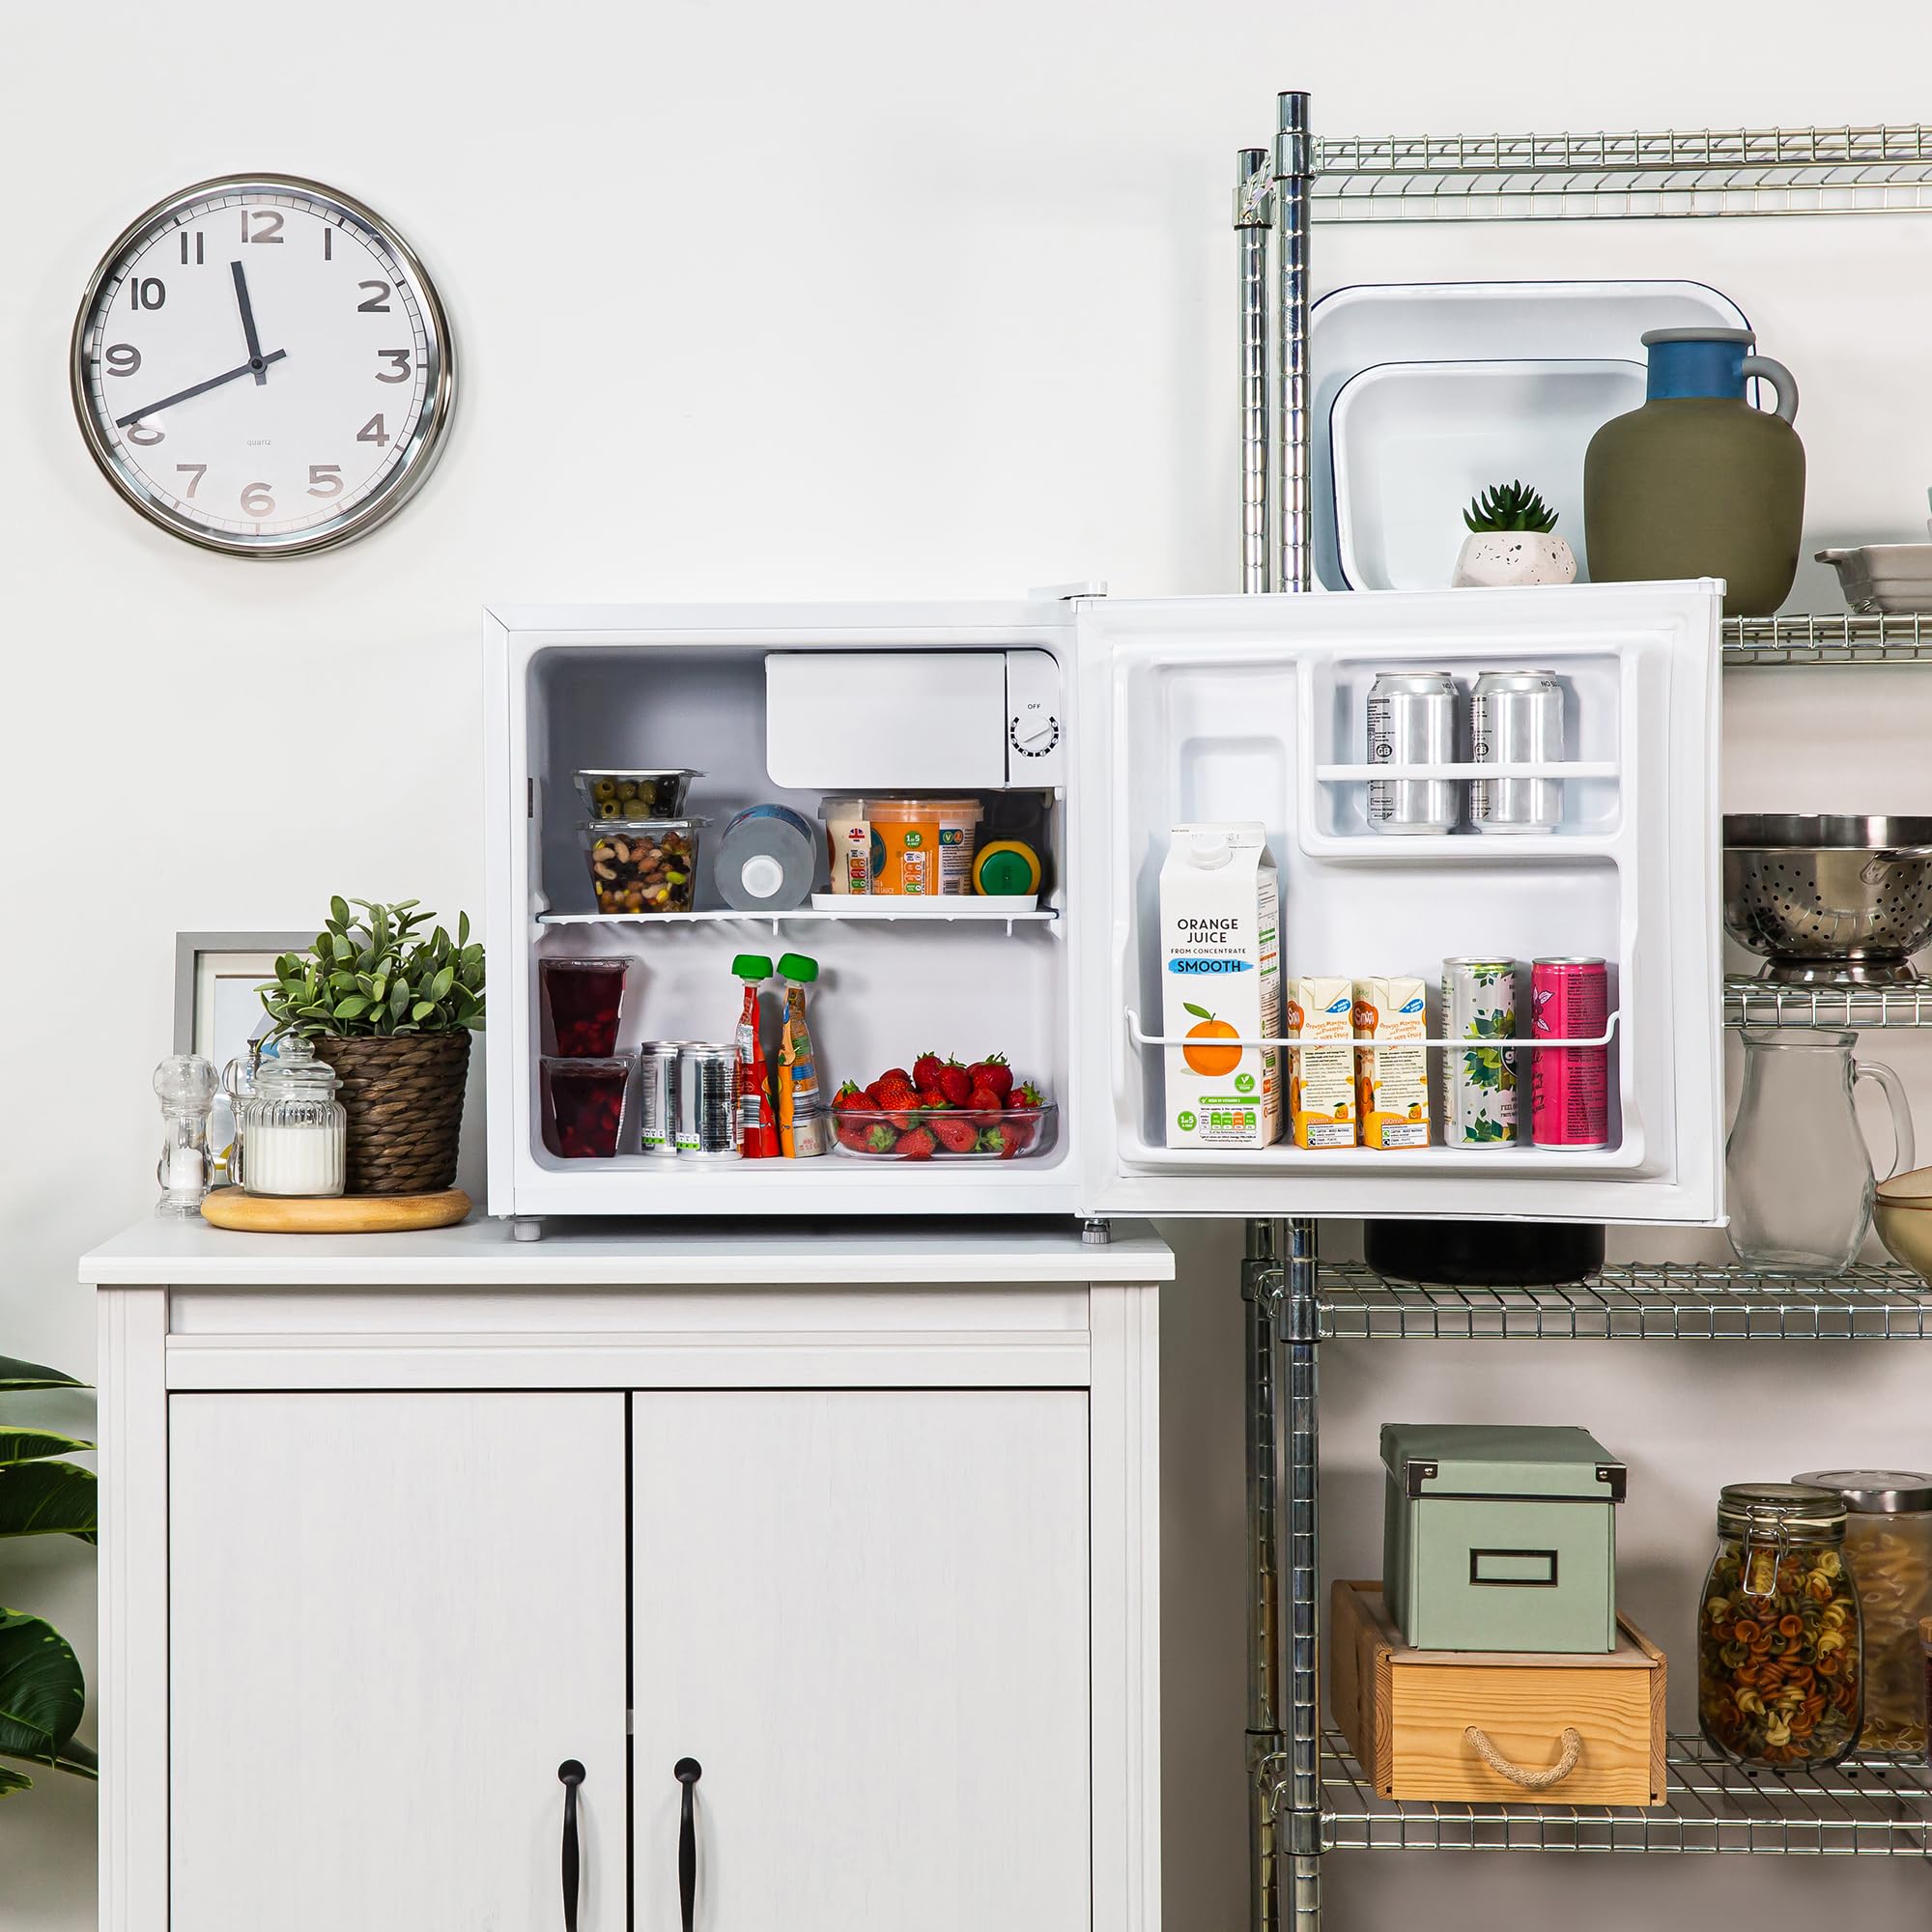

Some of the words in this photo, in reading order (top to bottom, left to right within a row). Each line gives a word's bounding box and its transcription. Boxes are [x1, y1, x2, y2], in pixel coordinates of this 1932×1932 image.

[241, 210, 284, 243] 12
[181, 231, 204, 265] 11
[324, 227, 332, 261] 1
[130, 277, 166, 310] 10
[356, 280, 390, 313] 2
[105, 343, 142, 377] 9
[375, 349, 412, 384] 3
[355, 412, 390, 447] 4
[176, 464, 207, 498] 7
[306, 465, 344, 498] 5
[240, 482, 276, 518] 6
[1377, 746, 1391, 755] GB
[1178, 919, 1238, 929] ORANGE
[1186, 932, 1227, 943] JUICE
[1178, 960, 1240, 972] SMOOTH
